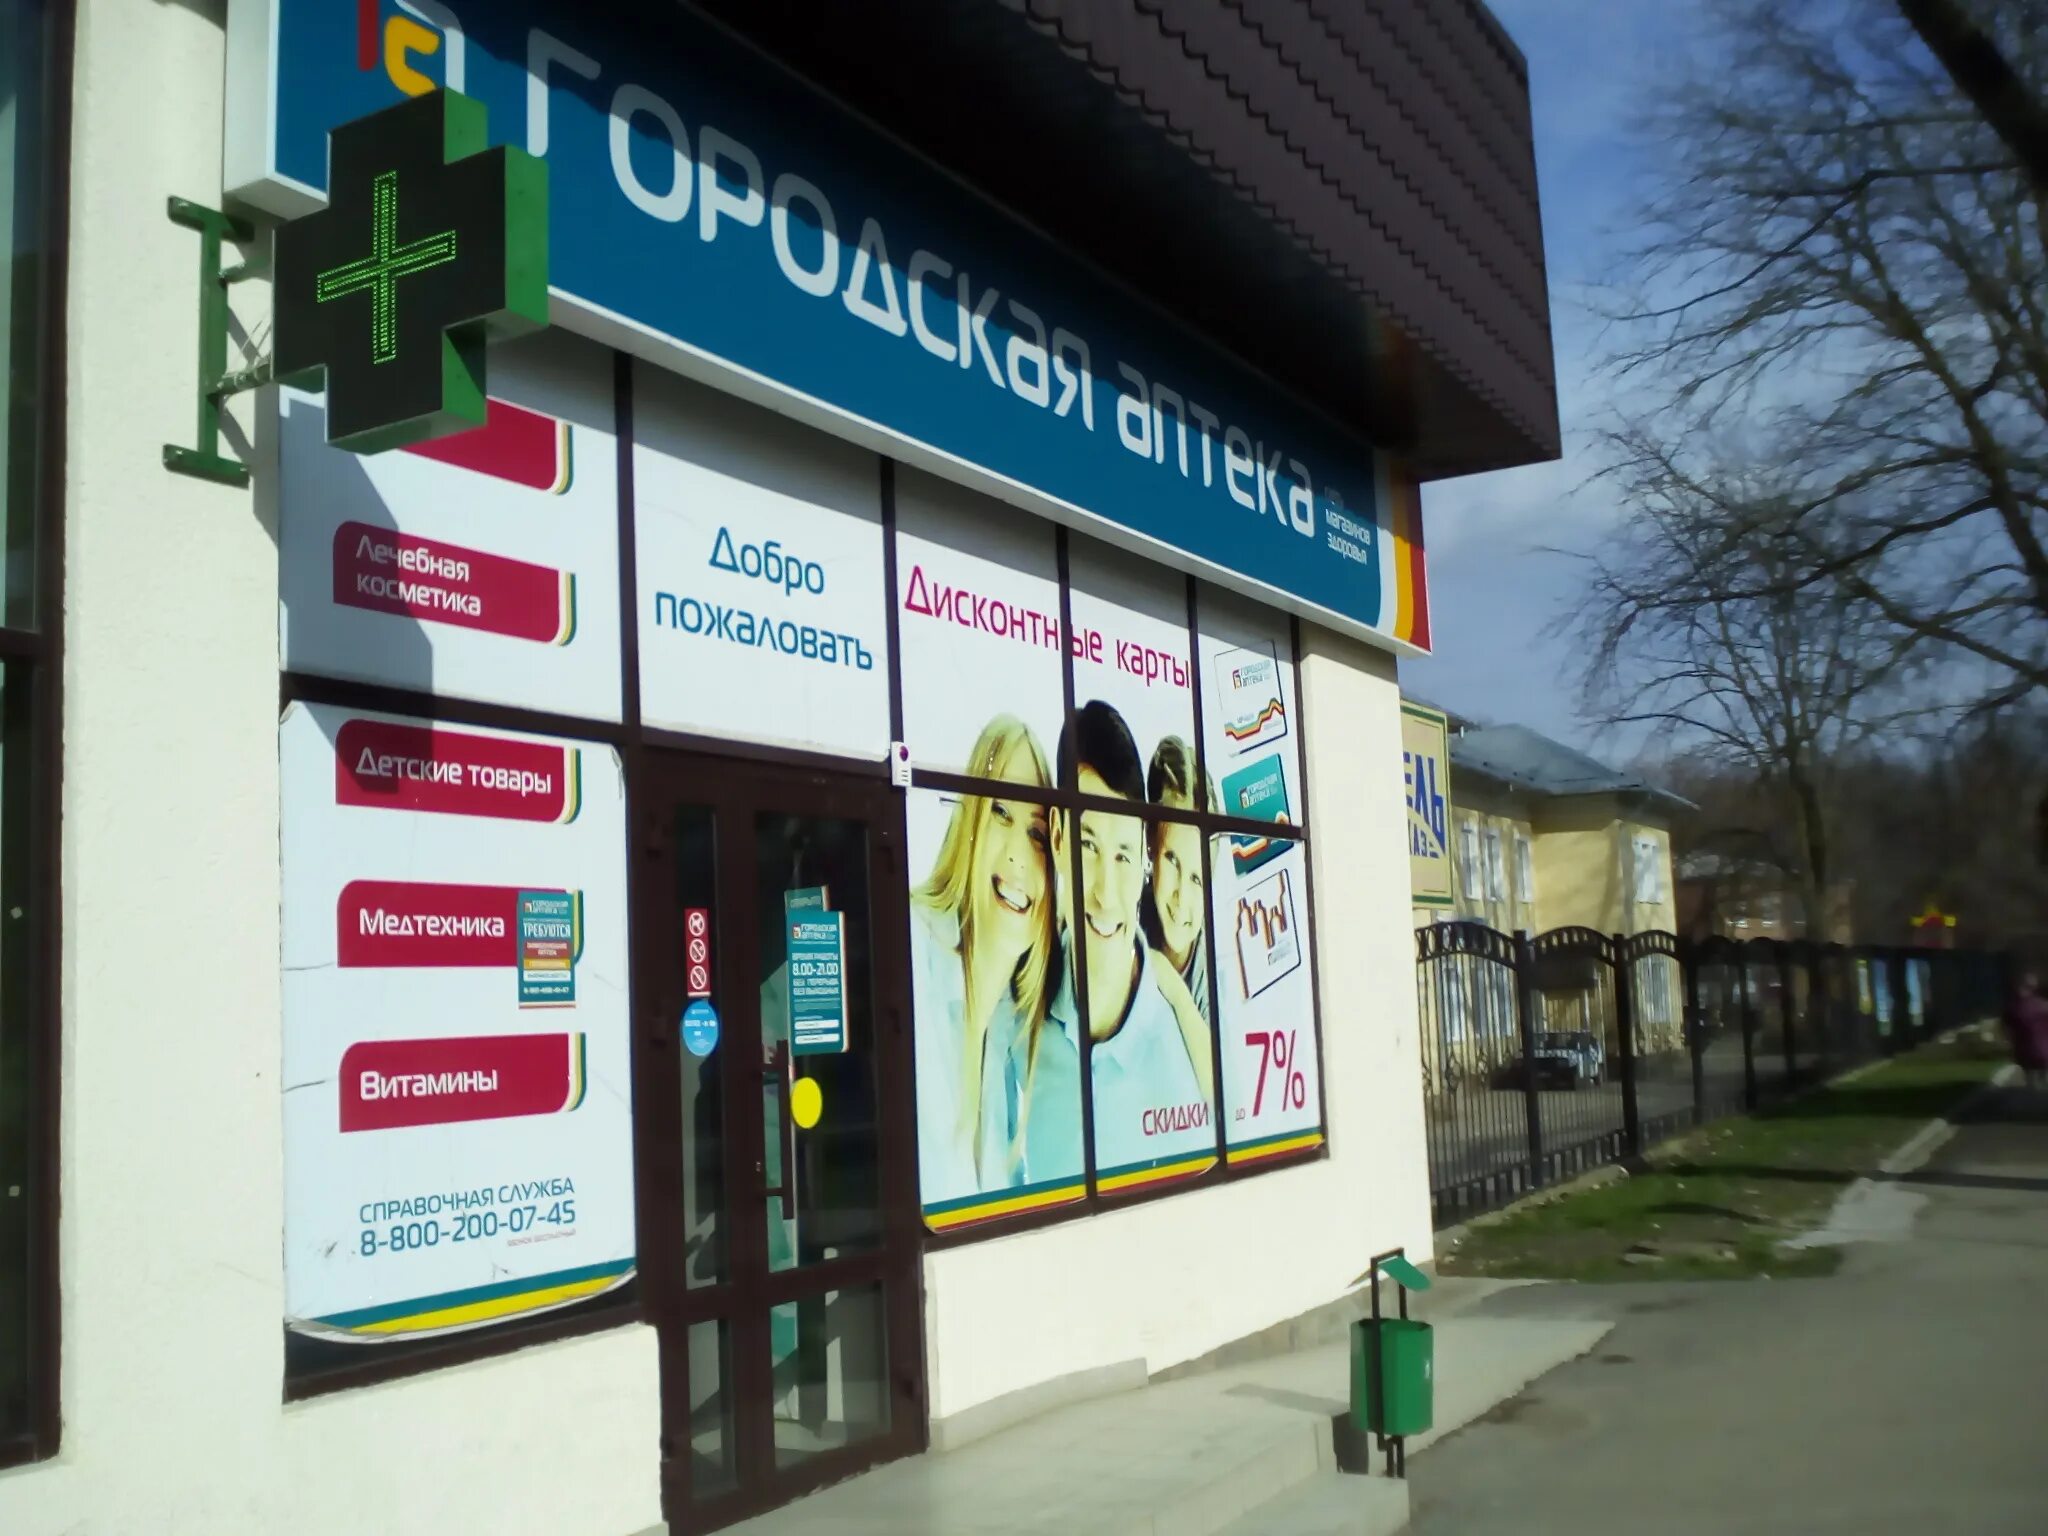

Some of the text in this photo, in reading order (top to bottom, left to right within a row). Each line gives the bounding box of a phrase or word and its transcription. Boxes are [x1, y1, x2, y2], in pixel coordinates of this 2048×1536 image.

[356, 534, 470, 583] Лечебная
[708, 527, 825, 597] Добро
[356, 573, 481, 617] косметика
[655, 592, 873, 671] пожаловать
[904, 565, 1190, 688] Дисконтные карты
[355, 746, 552, 796] Детские товары
[359, 908, 505, 938] Медтехника
[359, 1069, 498, 1101] Витамины
[1143, 1101, 1209, 1136] СКИДКИ
[1245, 1029, 1305, 1117] 7%
[359, 1177, 575, 1223] СПРАВОЧНАЯ СЛУЖБА
[360, 1200, 576, 1257] 8-800-200-07-45
